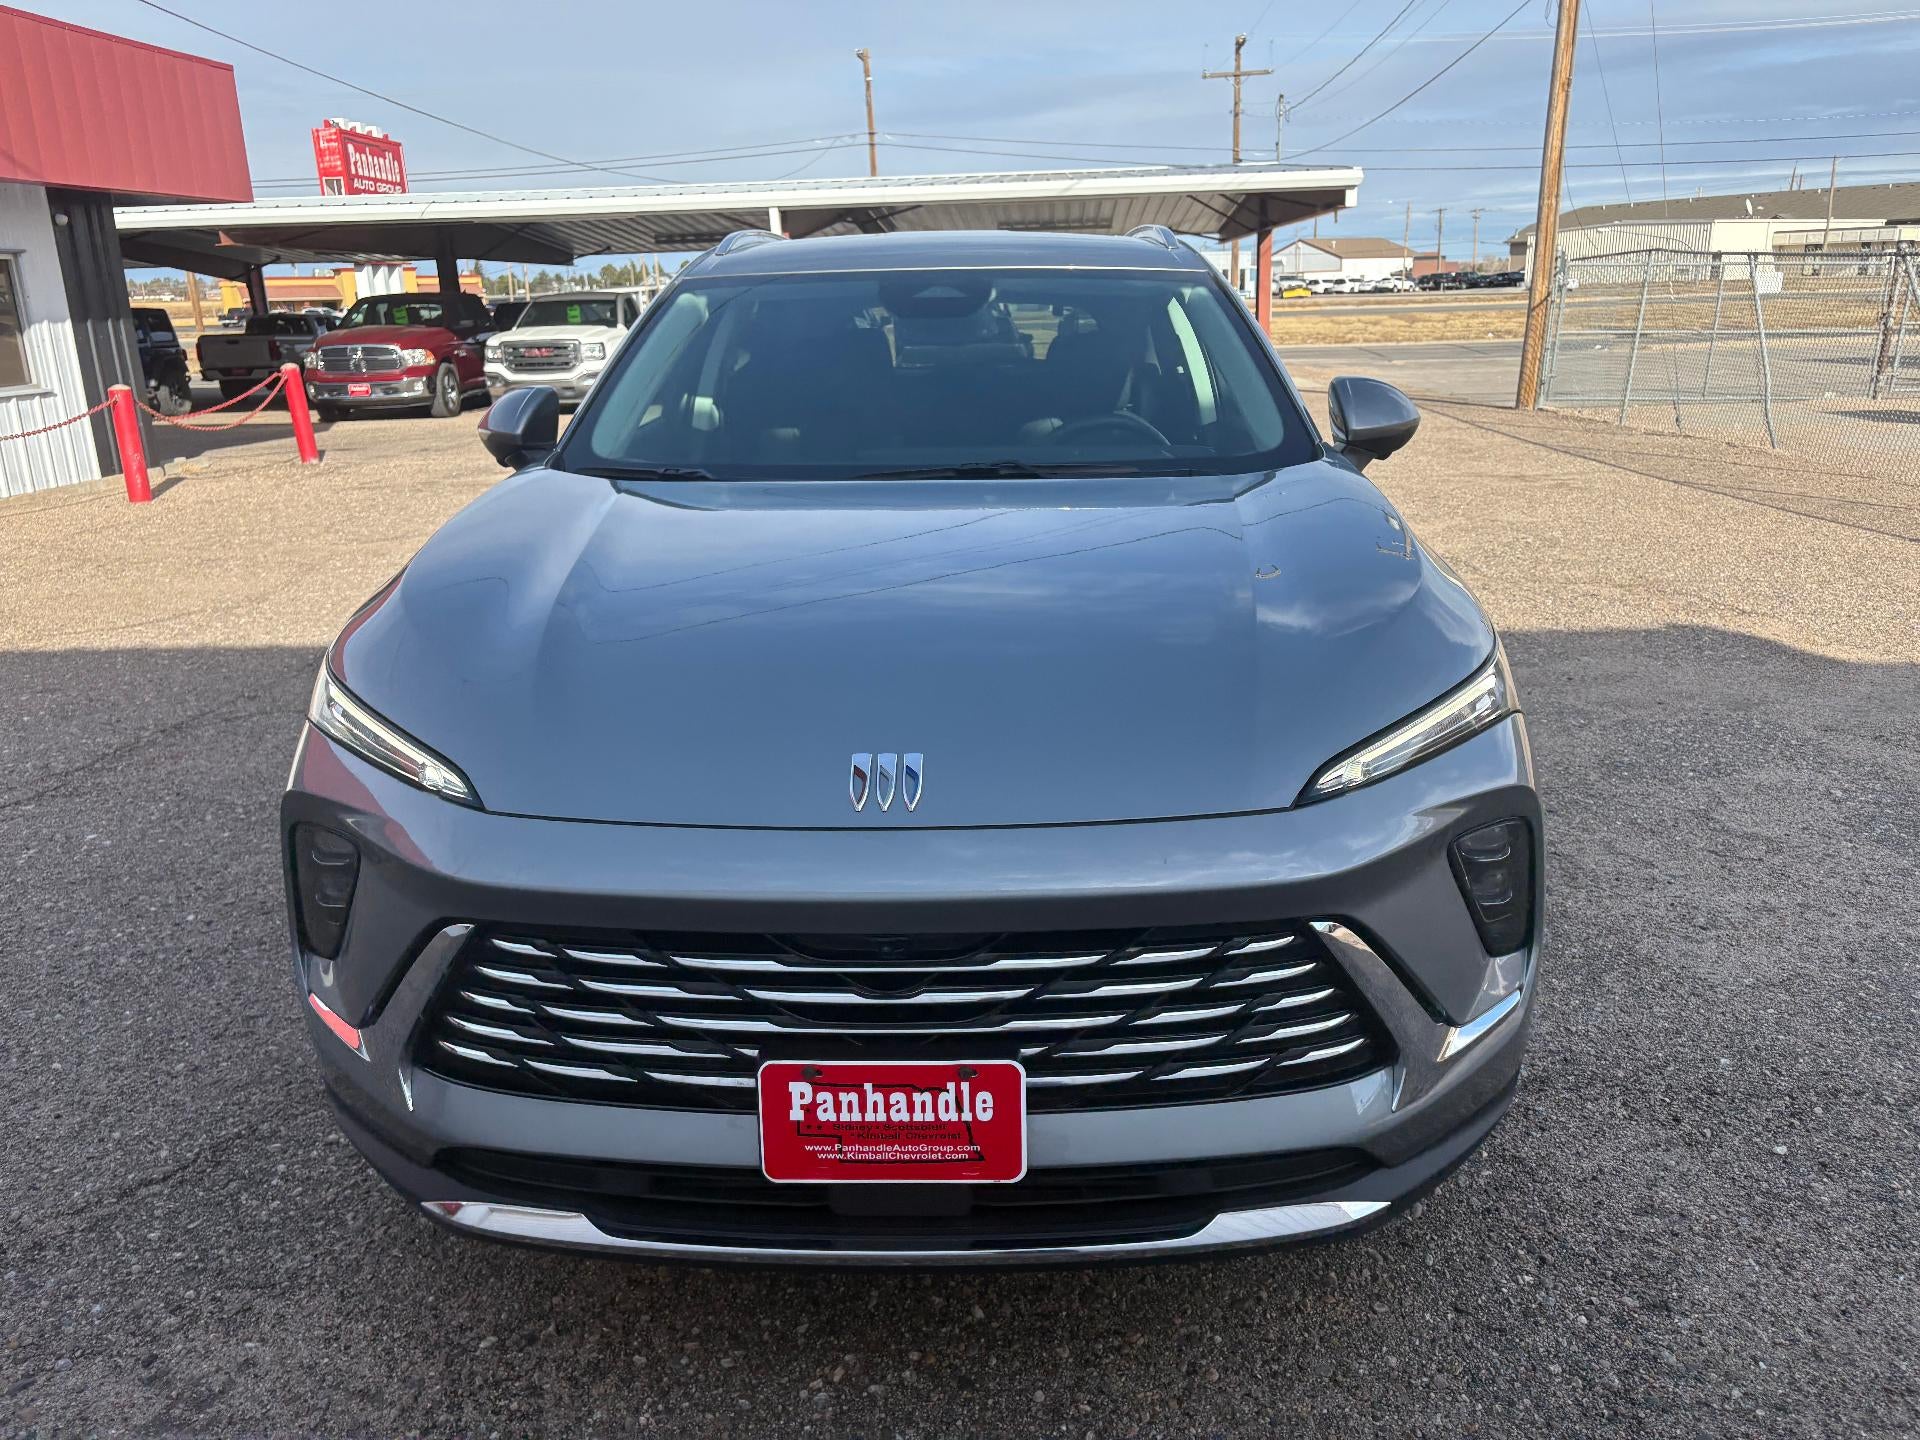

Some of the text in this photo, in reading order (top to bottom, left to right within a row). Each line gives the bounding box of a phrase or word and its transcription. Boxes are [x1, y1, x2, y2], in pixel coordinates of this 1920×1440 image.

[347, 143, 401, 183] Panhandle
[353, 178, 403, 194] AUTO GROUP
[788, 1081, 994, 1122] Panhandle
[857, 1132, 901, 1140] Kimball
[804, 1142, 981, 1153] www.PanhandleAutoGroup.com
[817, 1151, 969, 1160] www.KimballChevrolet.com
